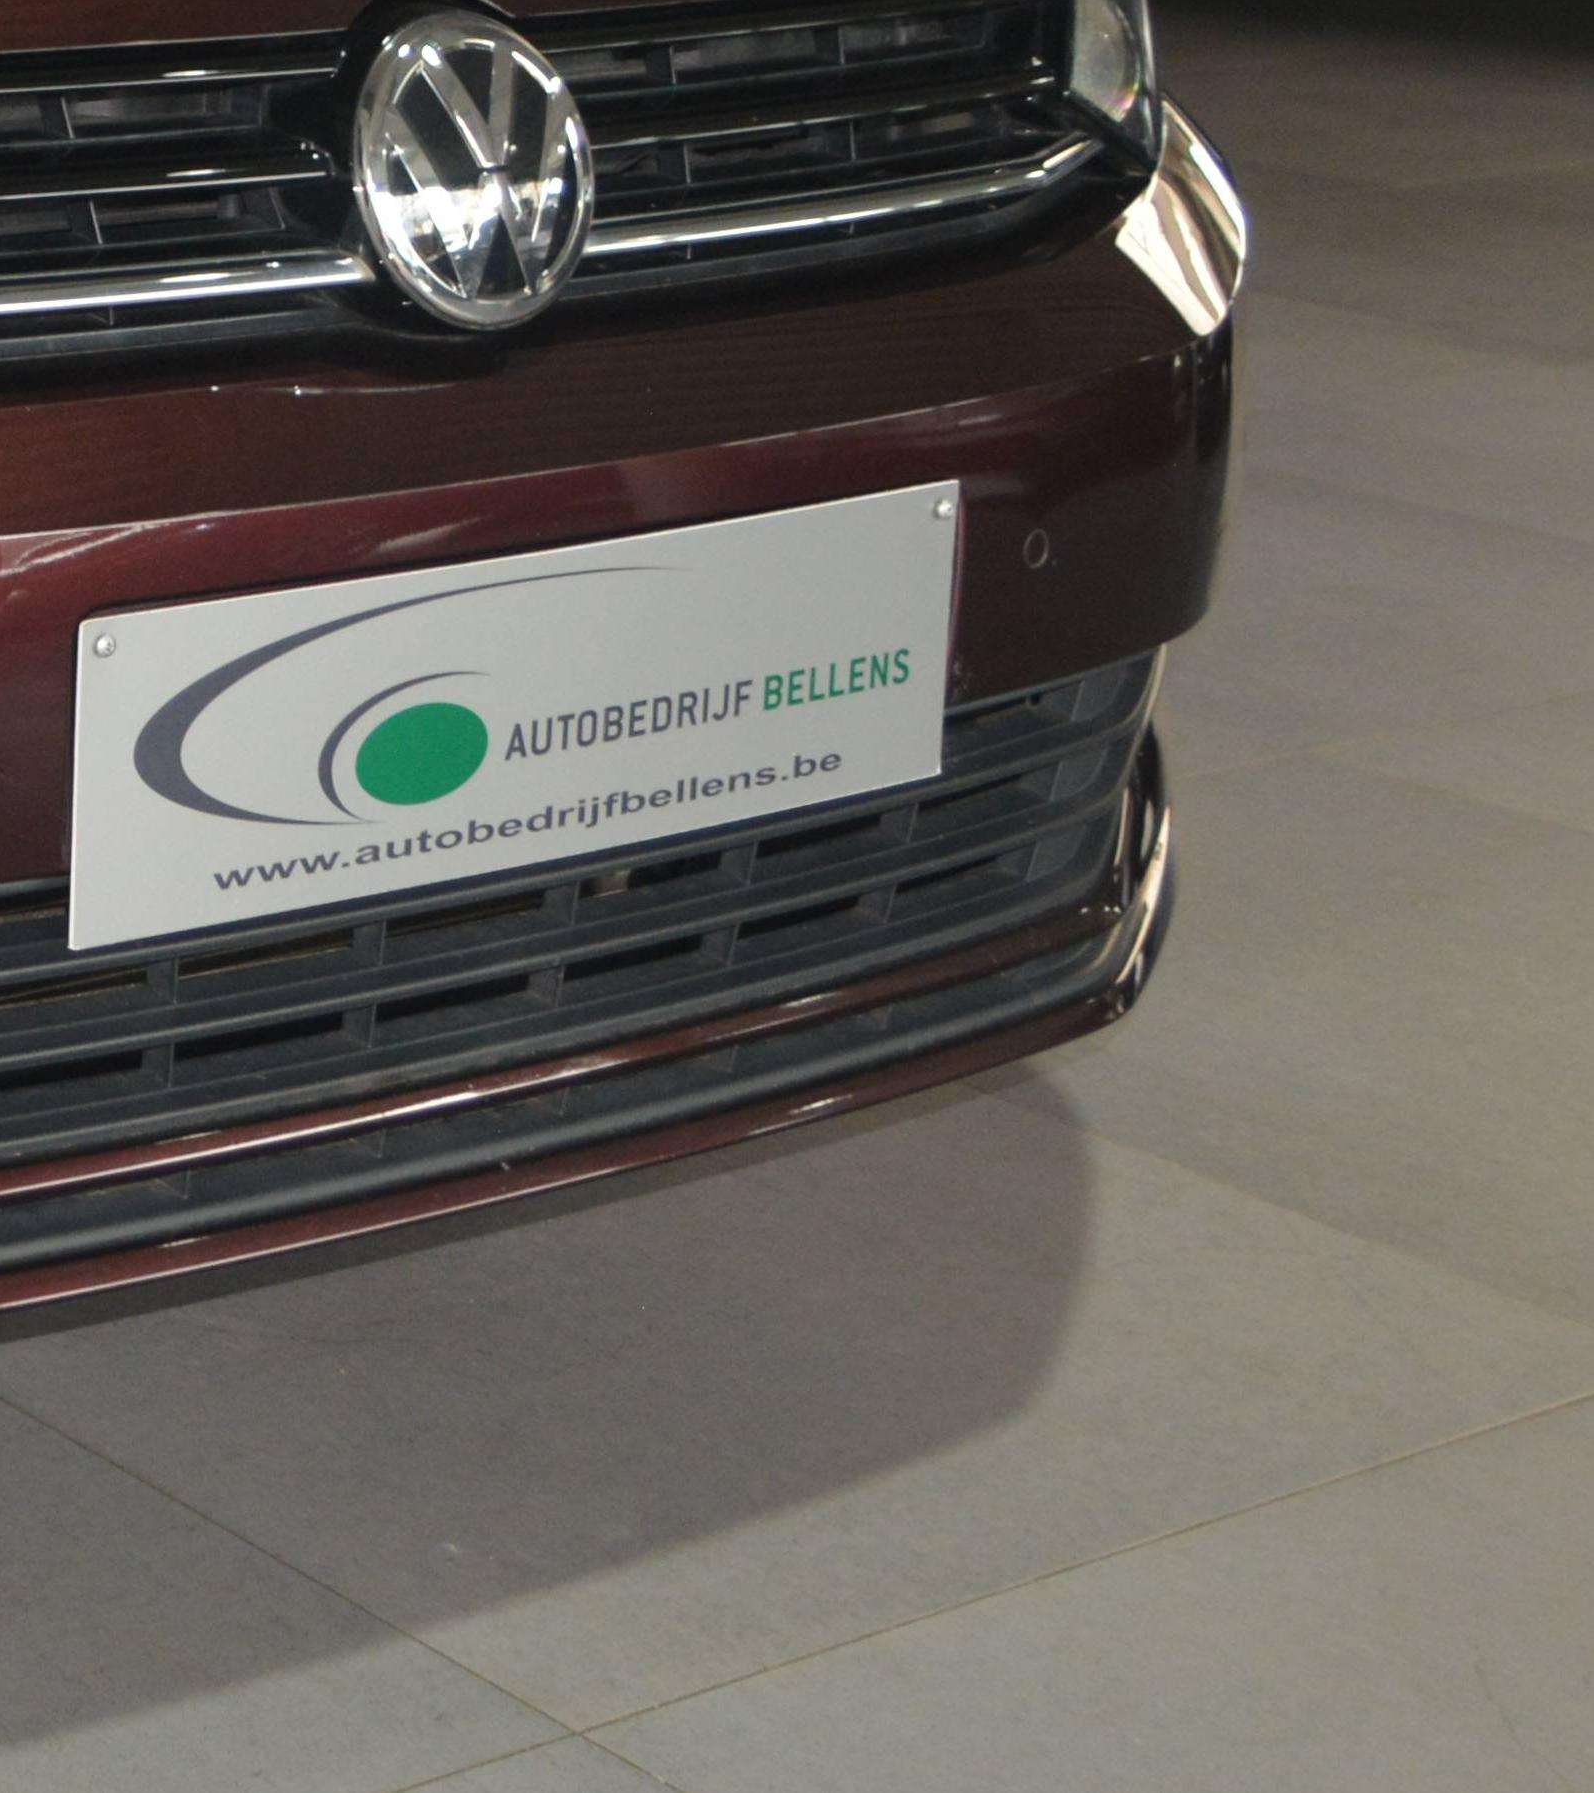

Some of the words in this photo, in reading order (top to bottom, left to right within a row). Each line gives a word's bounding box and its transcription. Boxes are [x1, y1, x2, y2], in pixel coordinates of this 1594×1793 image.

[504, 679, 754, 762] AUTOBEDRIJF
[762, 648, 910, 711] BELLENS
[213, 753, 842, 891] www.autobedrijfbellens.be
